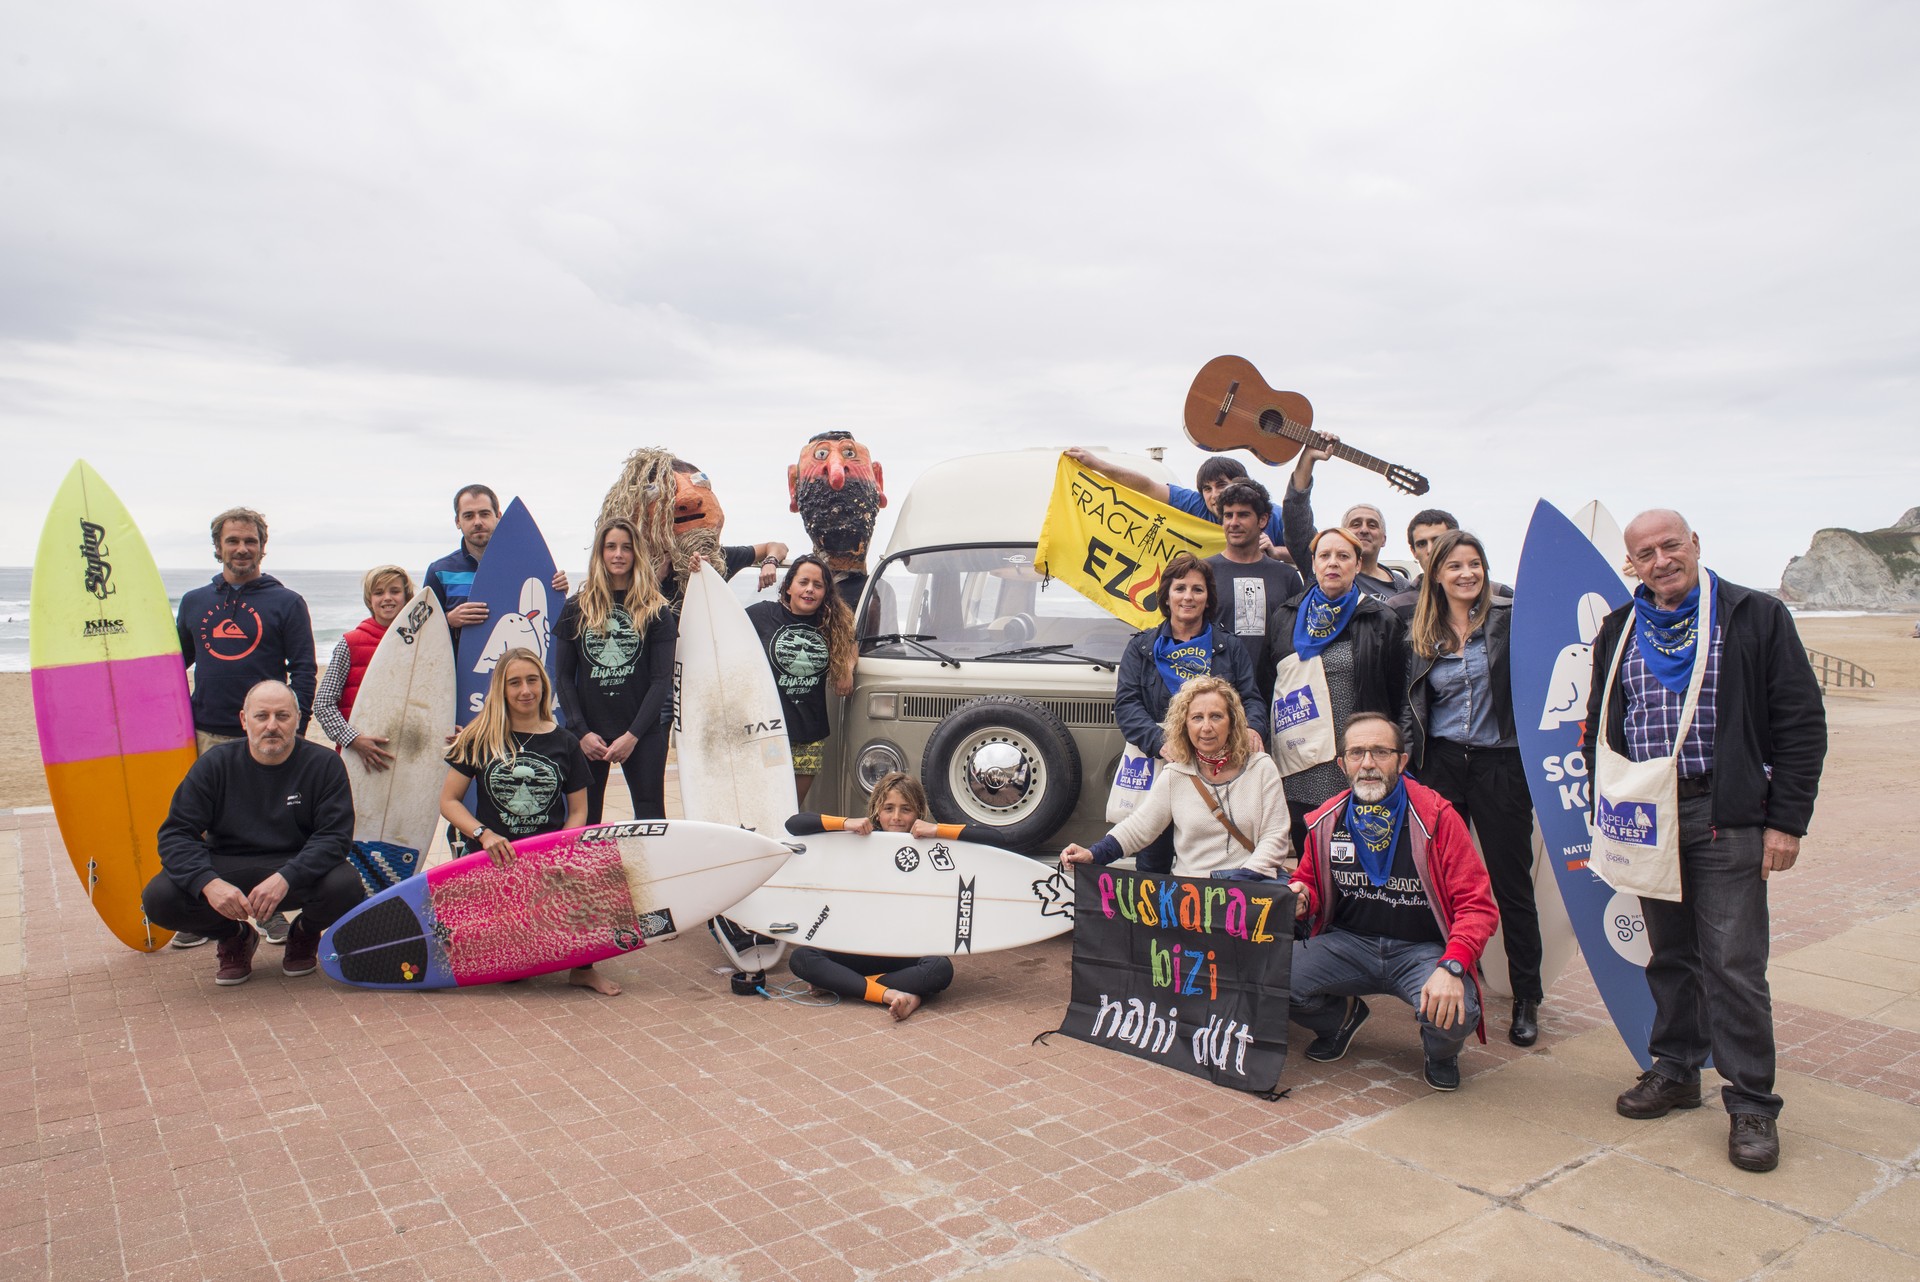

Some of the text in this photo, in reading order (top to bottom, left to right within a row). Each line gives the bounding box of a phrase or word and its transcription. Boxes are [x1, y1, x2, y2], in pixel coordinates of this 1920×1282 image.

[85, 619, 124, 629] Kike
[1167, 647, 1206, 660] opela
[1293, 707, 1311, 720] FEST
[1355, 804, 1391, 818] opela
[1602, 812, 1635, 828] OPELA
[581, 824, 667, 841] PUKAS
[1619, 827, 1648, 839] FEST
[896, 851, 912, 872] WAX
[903, 847, 919, 866] SEX
[1385, 876, 1422, 892] CAN
[958, 889, 972, 939] SUPER!
[1098, 873, 1274, 943] euskaraz
[1150, 938, 1218, 1000] bizi
[1091, 994, 1254, 1075] nahi dut
